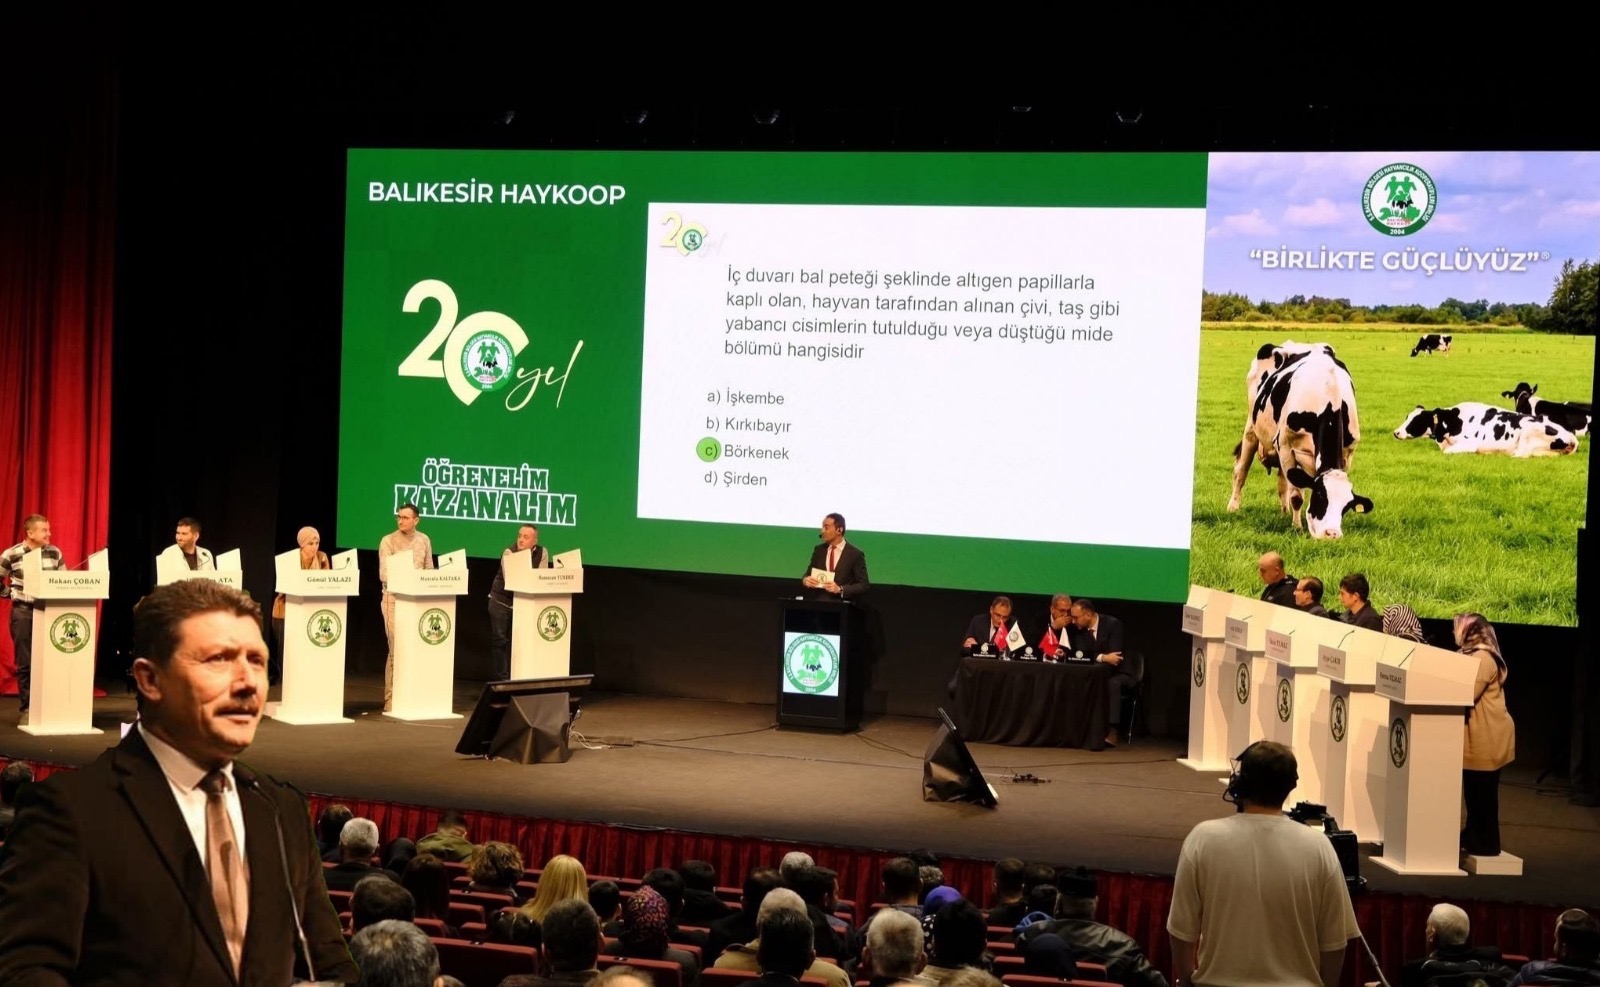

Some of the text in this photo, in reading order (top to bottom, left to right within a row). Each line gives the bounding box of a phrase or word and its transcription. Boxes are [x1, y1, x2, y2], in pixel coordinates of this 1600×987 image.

[368, 178, 626, 206] BALIKESİR HAYKOOP
[728, 265, 1094, 292] İç duvarı bal peteği şeklinde altıgen papillarla
[727, 291, 1119, 320] kaplı olan, hayvan tarafından alınan çivi, taş gibi
[726, 316, 1113, 344] yabancı cisimlerin tutulduğu veya düştüğü mide
[725, 340, 864, 361] bölümü hangisidir
[708, 387, 784, 406] a) İşkembe
[707, 417, 791, 435] b) Kırkıbayır
[705, 443, 789, 459] c) Börkenek
[423, 458, 549, 491] ÖĞRENELİM
[704, 471, 767, 487] d) Şirden
[394, 484, 578, 527] KAZANALIM
[73, 577, 101, 585] ÇOBAN
